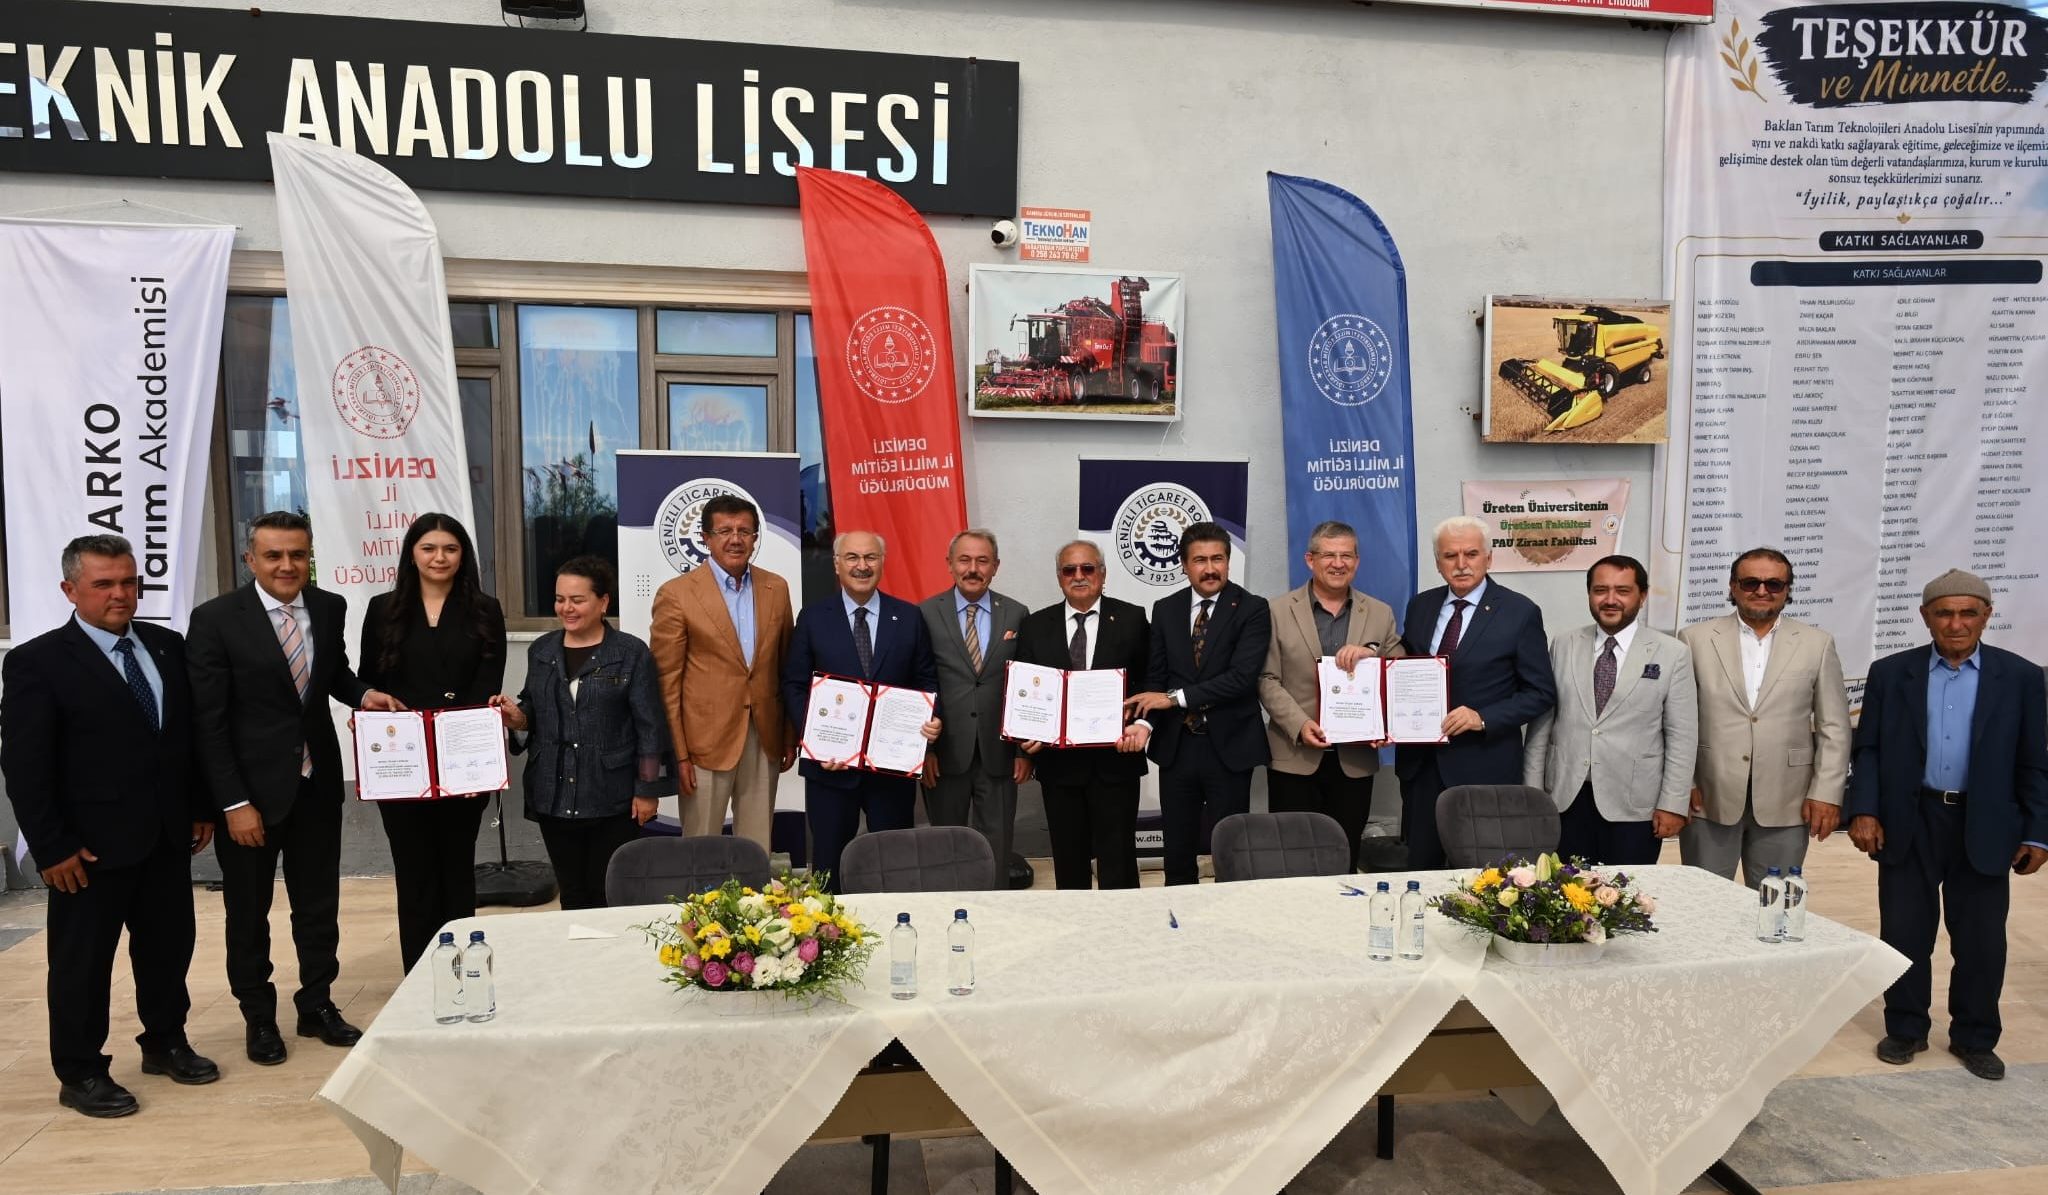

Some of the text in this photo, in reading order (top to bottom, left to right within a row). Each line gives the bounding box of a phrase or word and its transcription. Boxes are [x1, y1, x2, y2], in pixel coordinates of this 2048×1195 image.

[1792, 9, 2028, 69] TEŞEKKÜR
[1821, 57, 2025, 102] ve Minnetle...
[0, 32, 949, 186] EKNİK ANADOLU LİSESİ
[1764, 120, 1802, 132] Baklan
[1805, 121, 1834, 133] Tarım
[1838, 122, 1901, 136] Teknolojileri
[1904, 123, 1945, 134] Anadolu
[1995, 123, 2045, 137] yapımında
[1752, 139, 1771, 151] aynı
[1774, 140, 1786, 149] ve
[1789, 138, 1818, 149] nakdi
[1821, 138, 1844, 150] katkı
[1848, 138, 1899, 153] sağlayarak
[1903, 140, 1941, 153] eğitime,
[1943, 140, 2001, 154] geleceğimize
[2004, 142, 2015, 150] ve
[1719, 153, 1767, 168] gelişimine
[1770, 155, 1803, 166] destek
[1806, 155, 1828, 166] olan
[1831, 156, 1848, 167] tüm
[1851, 156, 1884, 170] değerli
[1969, 156, 2000, 167] kurum
[2003, 158, 2013, 167] ve
[2015, 156, 2048, 168] kurulu
[1828, 172, 1983, 187] sonsuz teşekkürlerimizi sunarız.
[1856, 192, 1938, 210] paylaştıkça
[1835, 233, 1968, 247] KATKI SAĞLAYANLAR
[1853, 266, 1947, 279] KATKI SAĞLAYANLAR
[131, 276, 169, 599] Tarım Akademisi
[84, 403, 124, 534] ARKO
[1482, 500, 1609, 514] Üreten Üniversitenin
[662, 488, 735, 556] DENİZLİ TİCARE
[1119, 492, 1188, 560] DENİZLİ TİCARET
[1545, 519, 1592, 530] Fakültesi
[1492, 536, 1597, 548] PAU Ziraat Fakültesi
[1150, 572, 1176, 582] 1923
